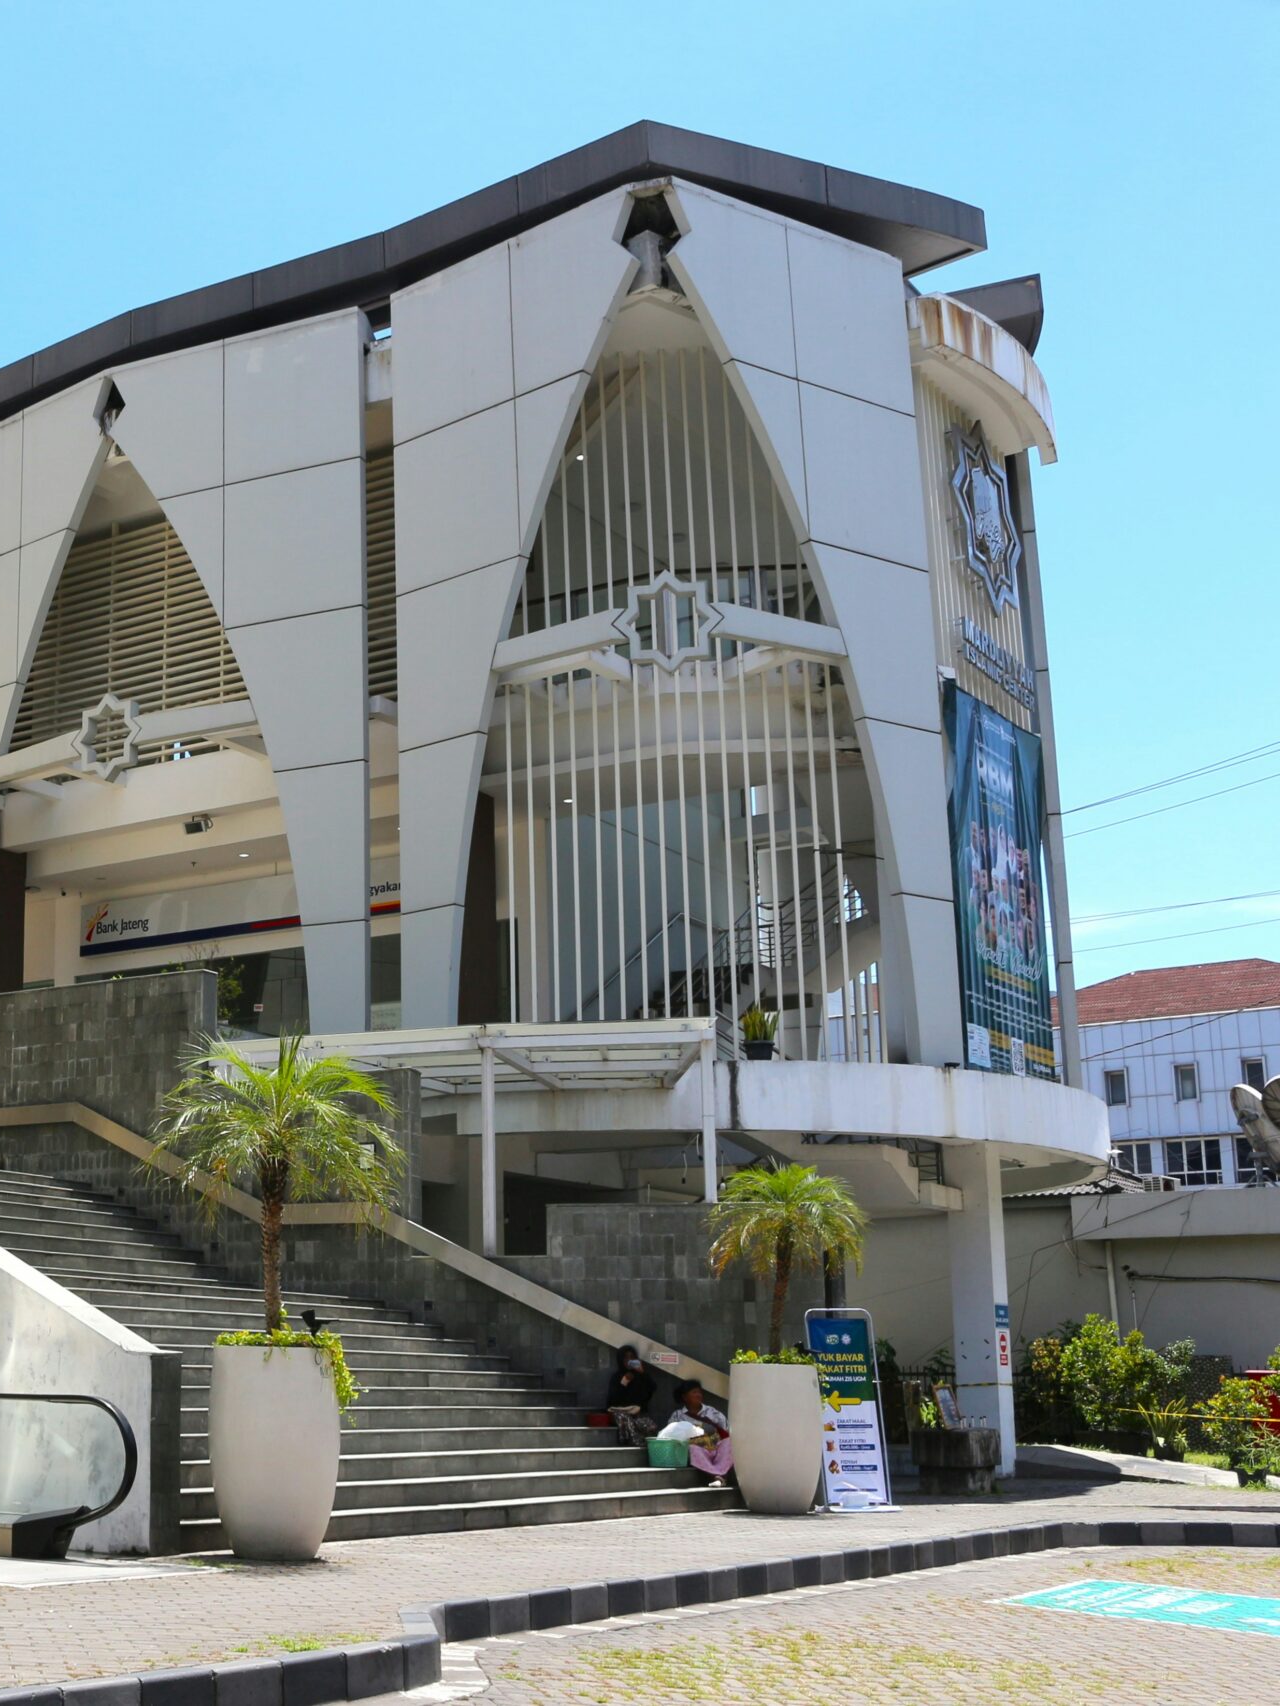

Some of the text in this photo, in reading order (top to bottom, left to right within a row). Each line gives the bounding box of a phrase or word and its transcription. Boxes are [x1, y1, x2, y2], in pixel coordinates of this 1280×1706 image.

[965, 643, 1035, 712] ISLAMIC CENTER
[96, 917, 149, 936] Bank Jateng
[818, 1353, 864, 1362] YUK BAYAR
[819, 1364, 867, 1373] AKAT FITRI
